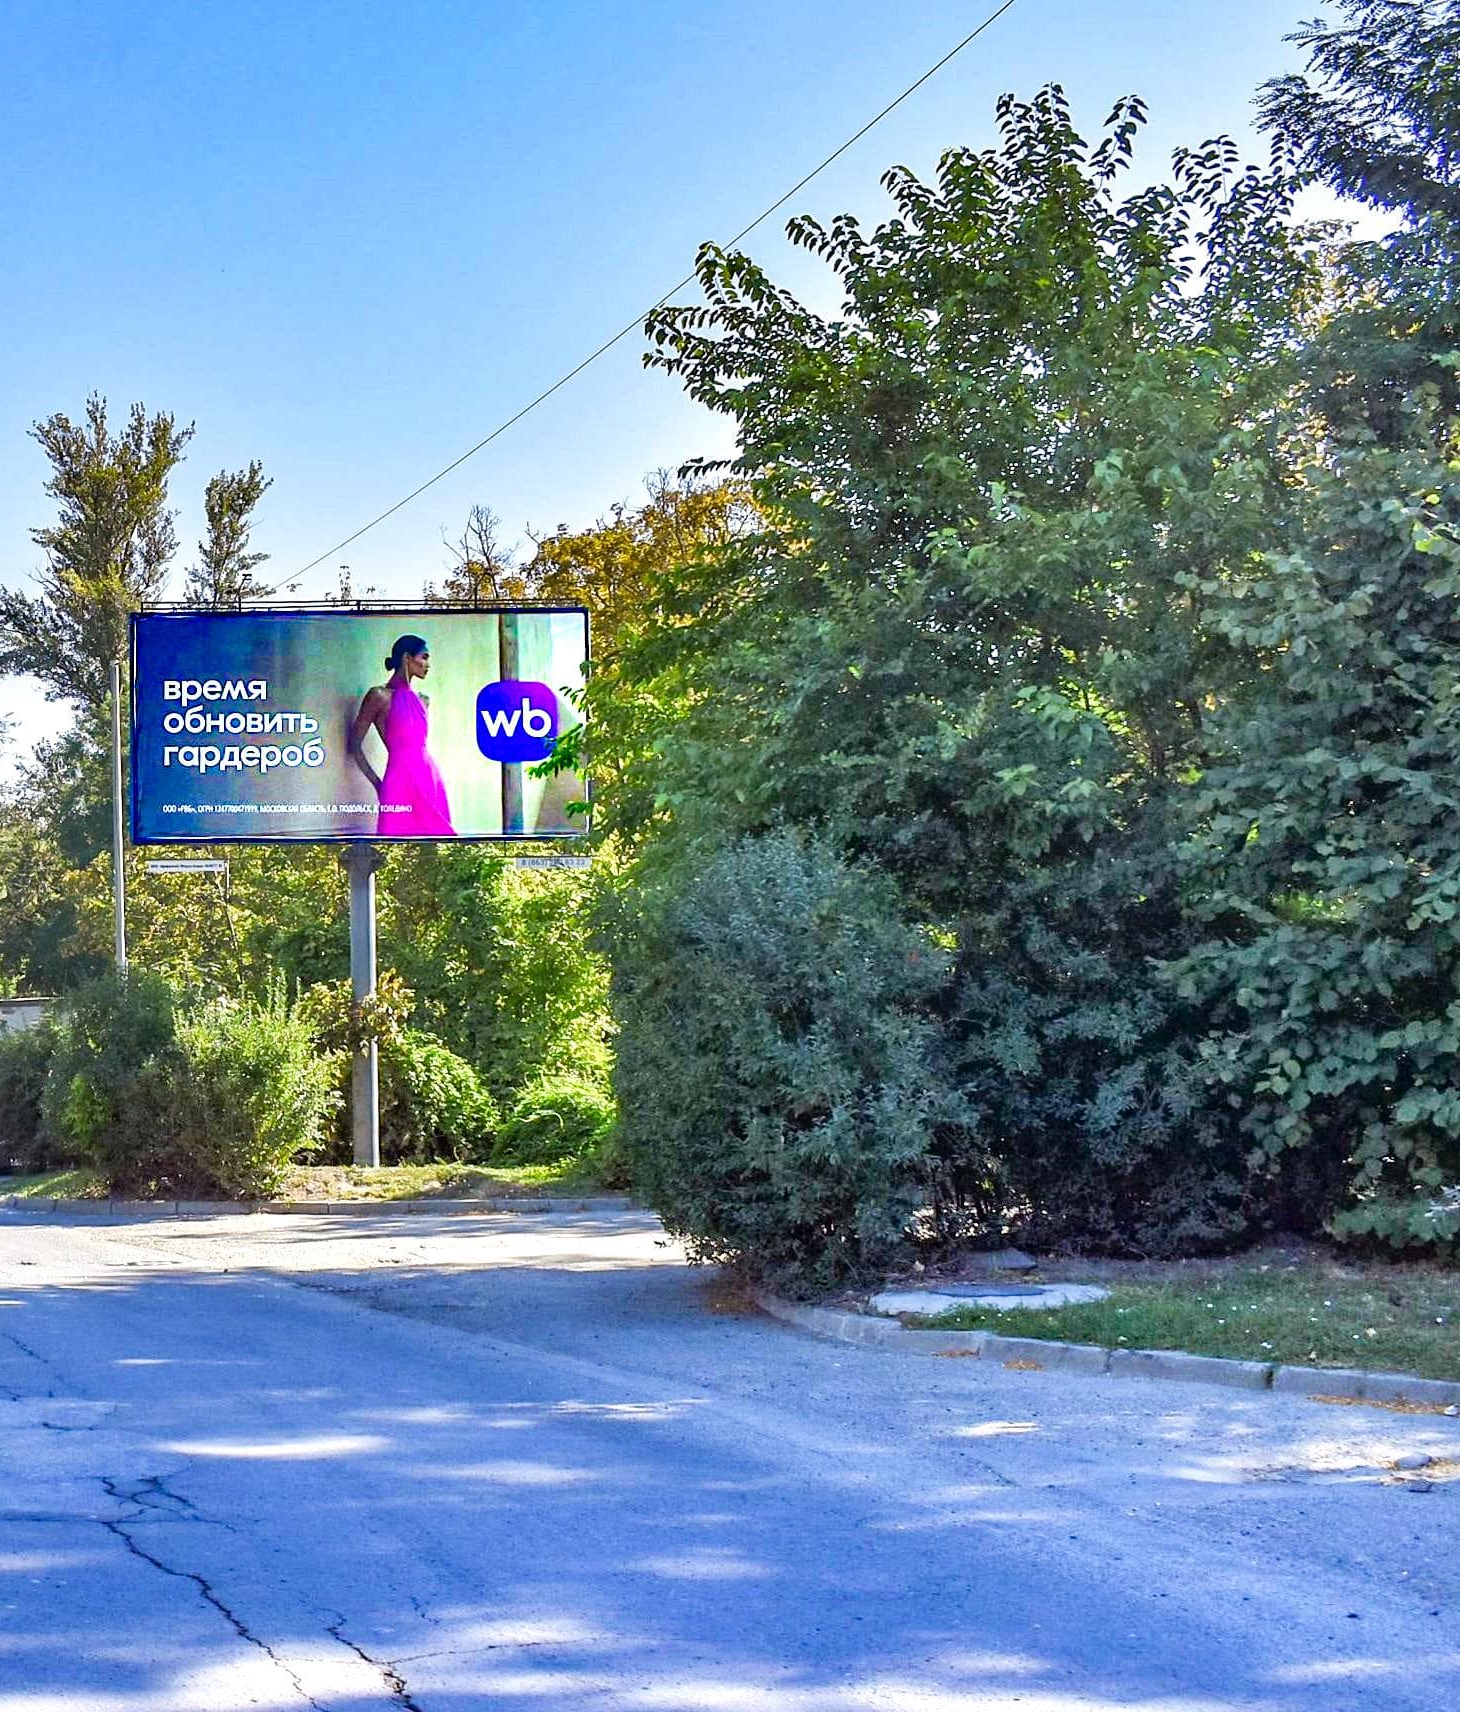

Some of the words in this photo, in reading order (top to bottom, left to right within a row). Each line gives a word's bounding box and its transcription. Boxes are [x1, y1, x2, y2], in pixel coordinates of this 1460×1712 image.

[163, 680, 267, 707] время
[163, 704, 319, 734] обновить
[481, 697, 552, 738] wb
[163, 737, 325, 774] гардероб
[162, 804, 177, 813] ООО
